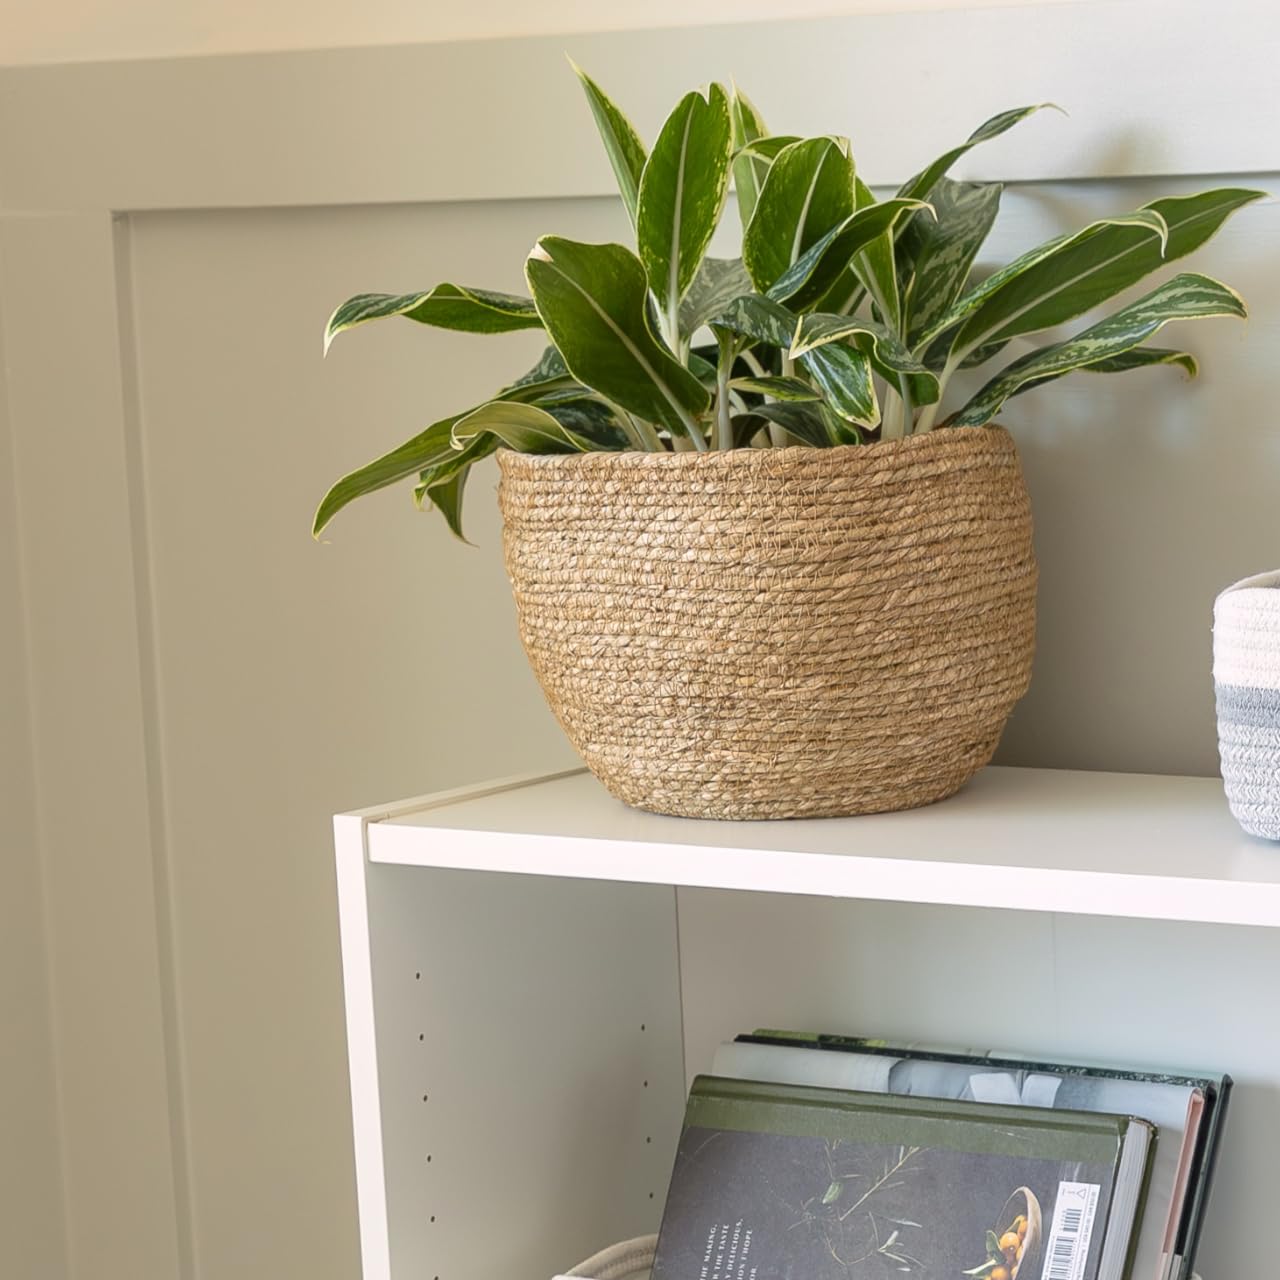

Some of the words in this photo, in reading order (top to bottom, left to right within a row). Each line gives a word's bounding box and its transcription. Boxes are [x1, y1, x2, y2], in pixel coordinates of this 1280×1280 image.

[714, 1253, 724, 1271] THE
[719, 1224, 730, 1250] TASTE
[742, 1229, 753, 1254] HOPE
